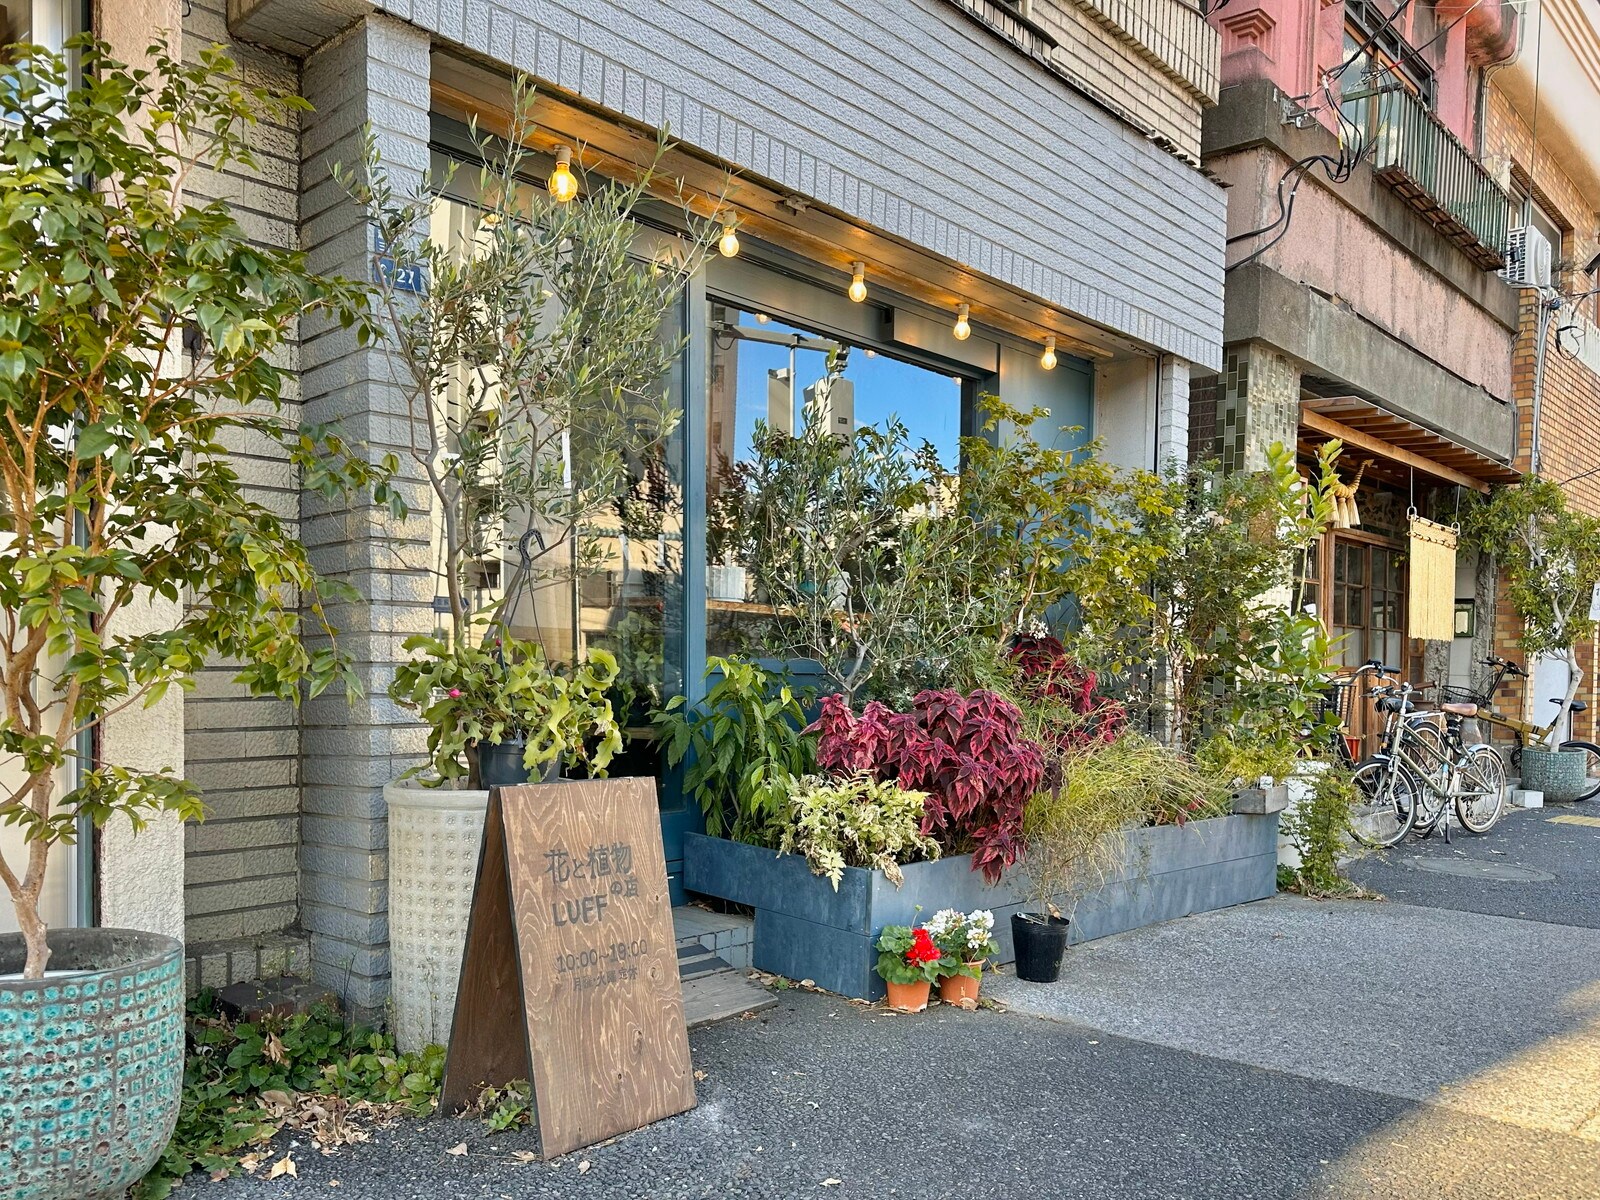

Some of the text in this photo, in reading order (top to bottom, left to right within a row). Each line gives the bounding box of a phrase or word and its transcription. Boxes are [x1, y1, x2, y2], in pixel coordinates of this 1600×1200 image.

[543, 842, 632, 884] 花と植物
[610, 877, 639, 898] の店
[552, 895, 608, 926] LUFF
